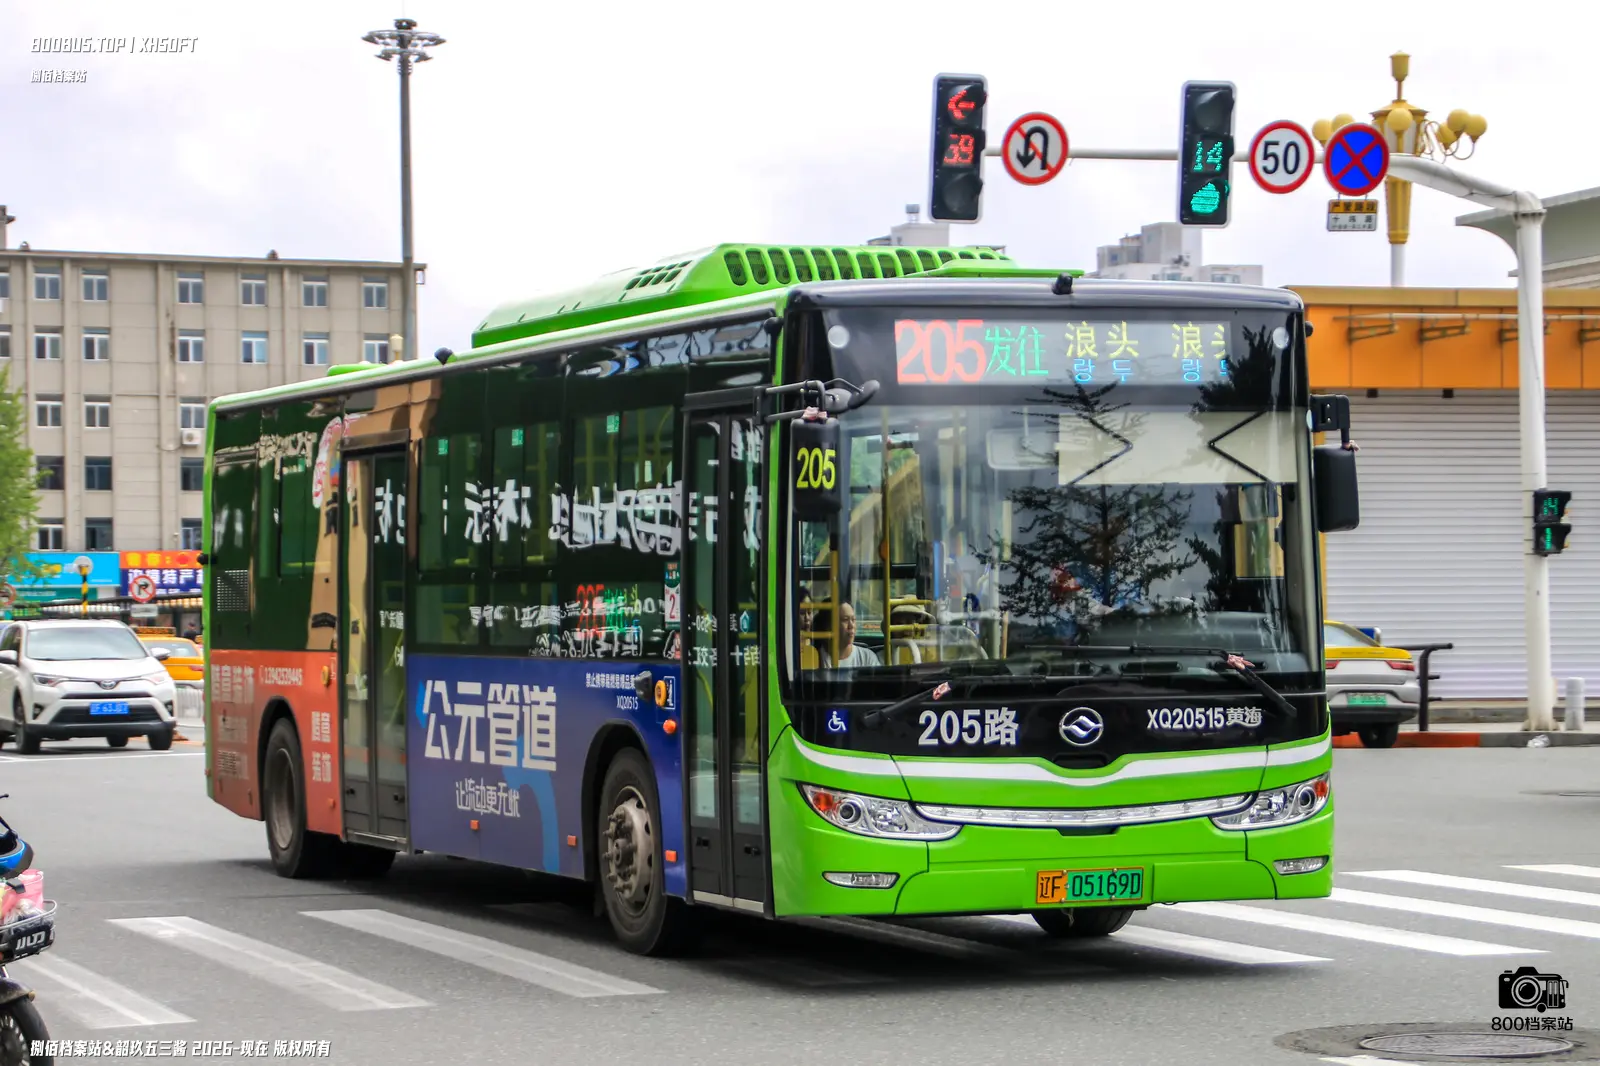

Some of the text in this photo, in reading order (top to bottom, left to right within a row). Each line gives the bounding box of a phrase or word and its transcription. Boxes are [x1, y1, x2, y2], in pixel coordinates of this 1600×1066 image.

[943, 134, 975, 165] 39
[1193, 141, 1223, 172] 14
[1261, 140, 1299, 176] 50
[894, 319, 986, 383] 205
[984, 325, 1049, 377] 发往
[1065, 320, 1139, 359] 浪头
[796, 447, 836, 489] 205
[585, 672, 639, 690] 禁止携带易燃易爆品乘
[616, 695, 639, 711] XQ20515
[423, 679, 557, 772] 公元管道
[918, 706, 1263, 747] 205路 XQ20515黄海
[455, 777, 521, 818] 让流动更无忧
